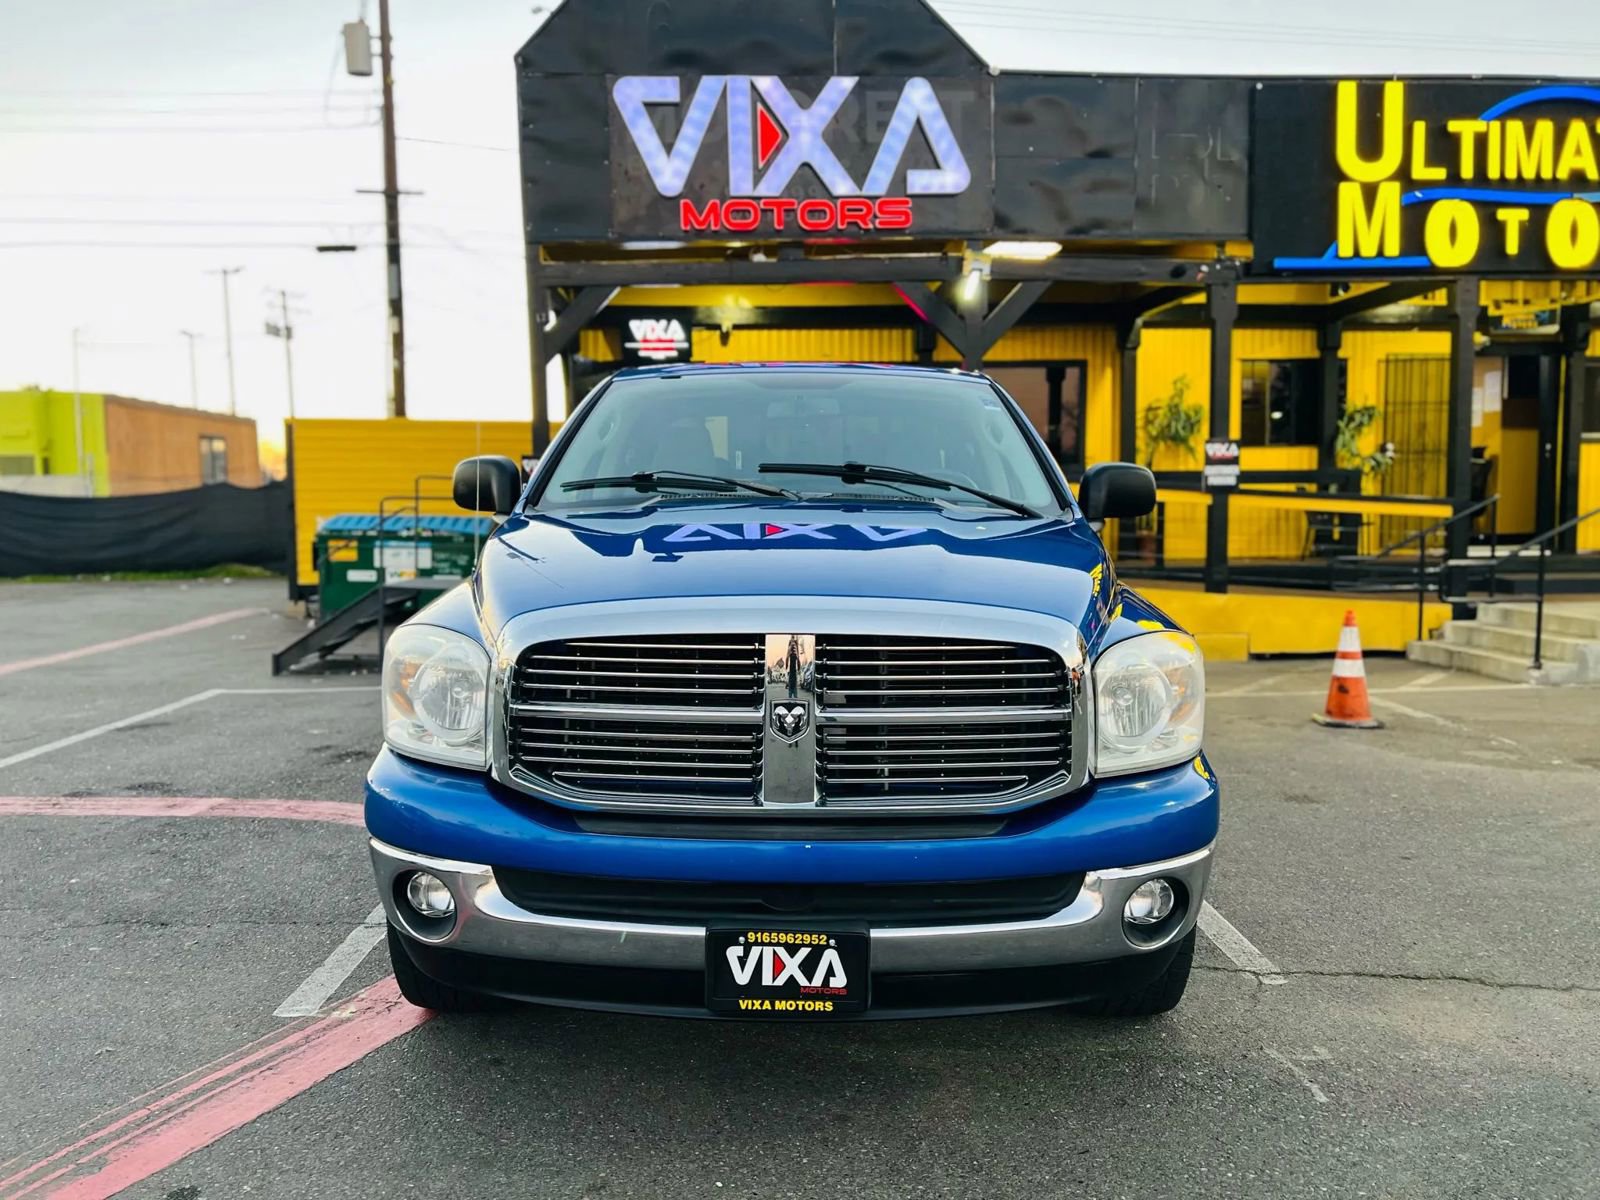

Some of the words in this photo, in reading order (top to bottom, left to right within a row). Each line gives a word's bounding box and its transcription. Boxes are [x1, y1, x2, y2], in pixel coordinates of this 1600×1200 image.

[612, 75, 971, 197] VIXA
[1335, 80, 1600, 181] ULTIMA
[680, 197, 913, 231] MOTORS
[747, 931, 828, 945] 9165962952
[725, 945, 848, 987] VIXA
[738, 999, 772, 1010] VIXA
[774, 1000, 834, 1011] MOTORS
[800, 987, 848, 995] MOTORS
